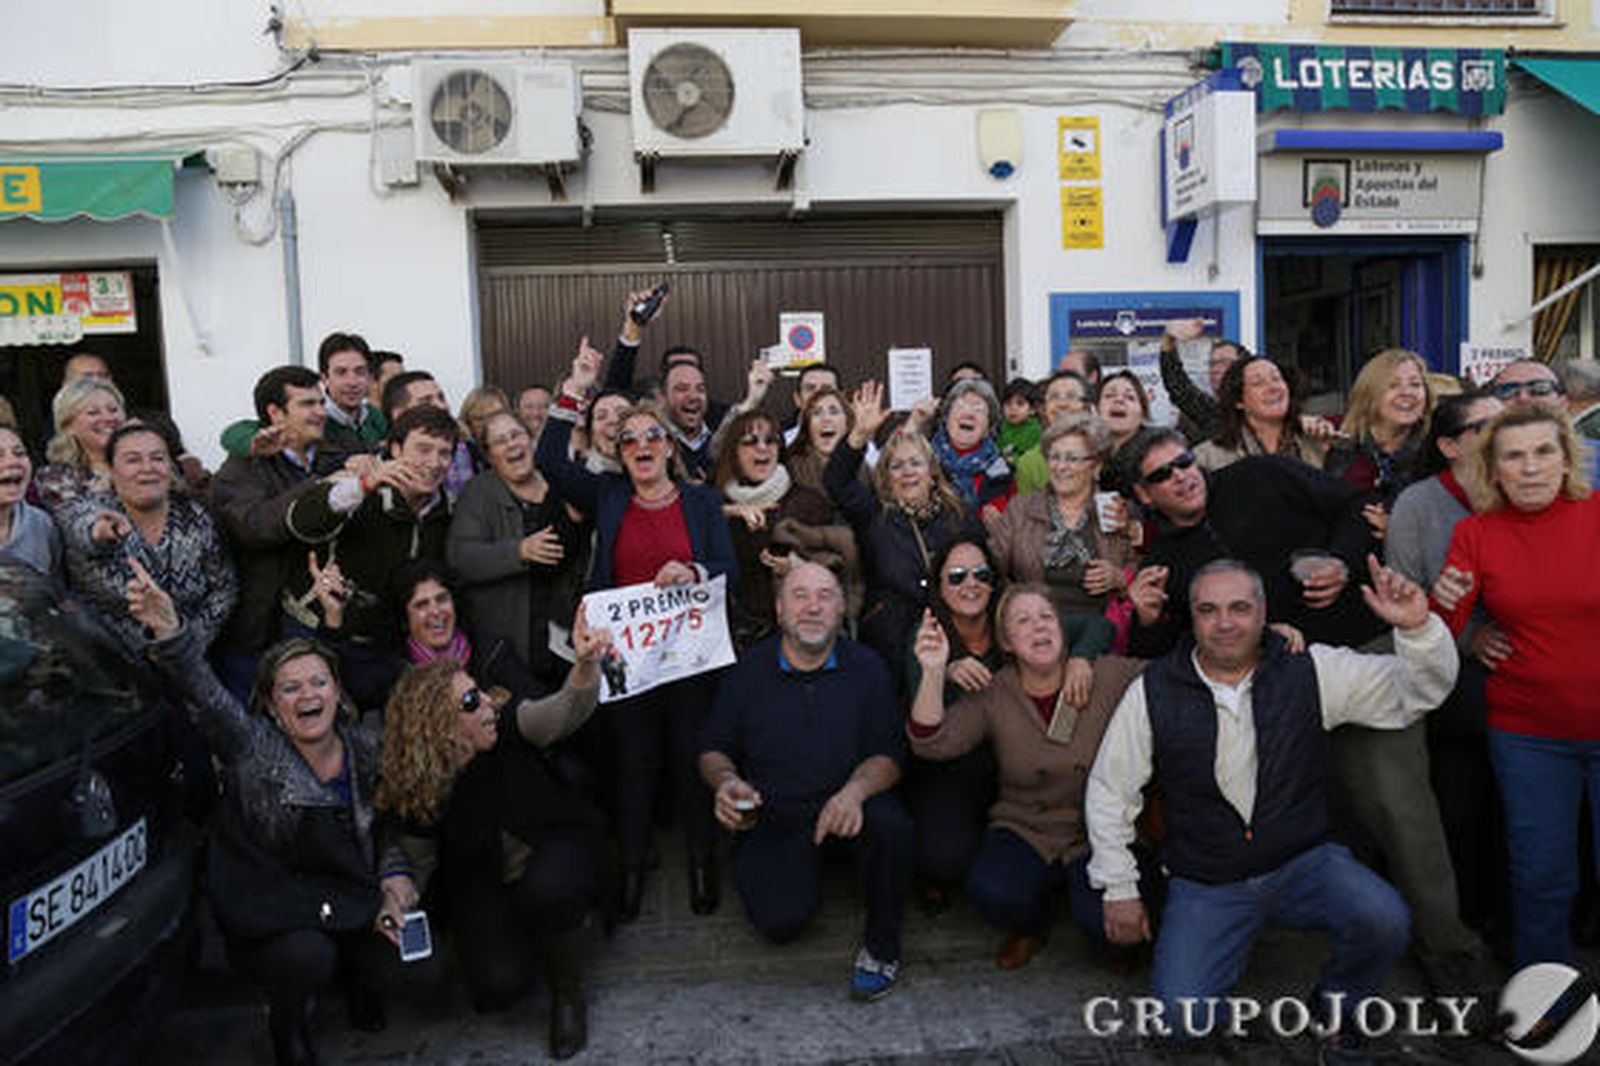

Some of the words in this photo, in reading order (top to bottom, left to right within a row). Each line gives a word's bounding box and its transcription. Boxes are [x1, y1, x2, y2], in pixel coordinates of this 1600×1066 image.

[1273, 57, 1454, 90] LOTERIAS
[1413, 161, 1423, 177] y
[1417, 177, 1438, 190] del
[1354, 193, 1400, 208] Estado
[628, 588, 710, 618] PREMIO
[621, 607, 703, 649] 12775
[28, 884, 66, 942] SE
[70, 845, 124, 914] 8414
